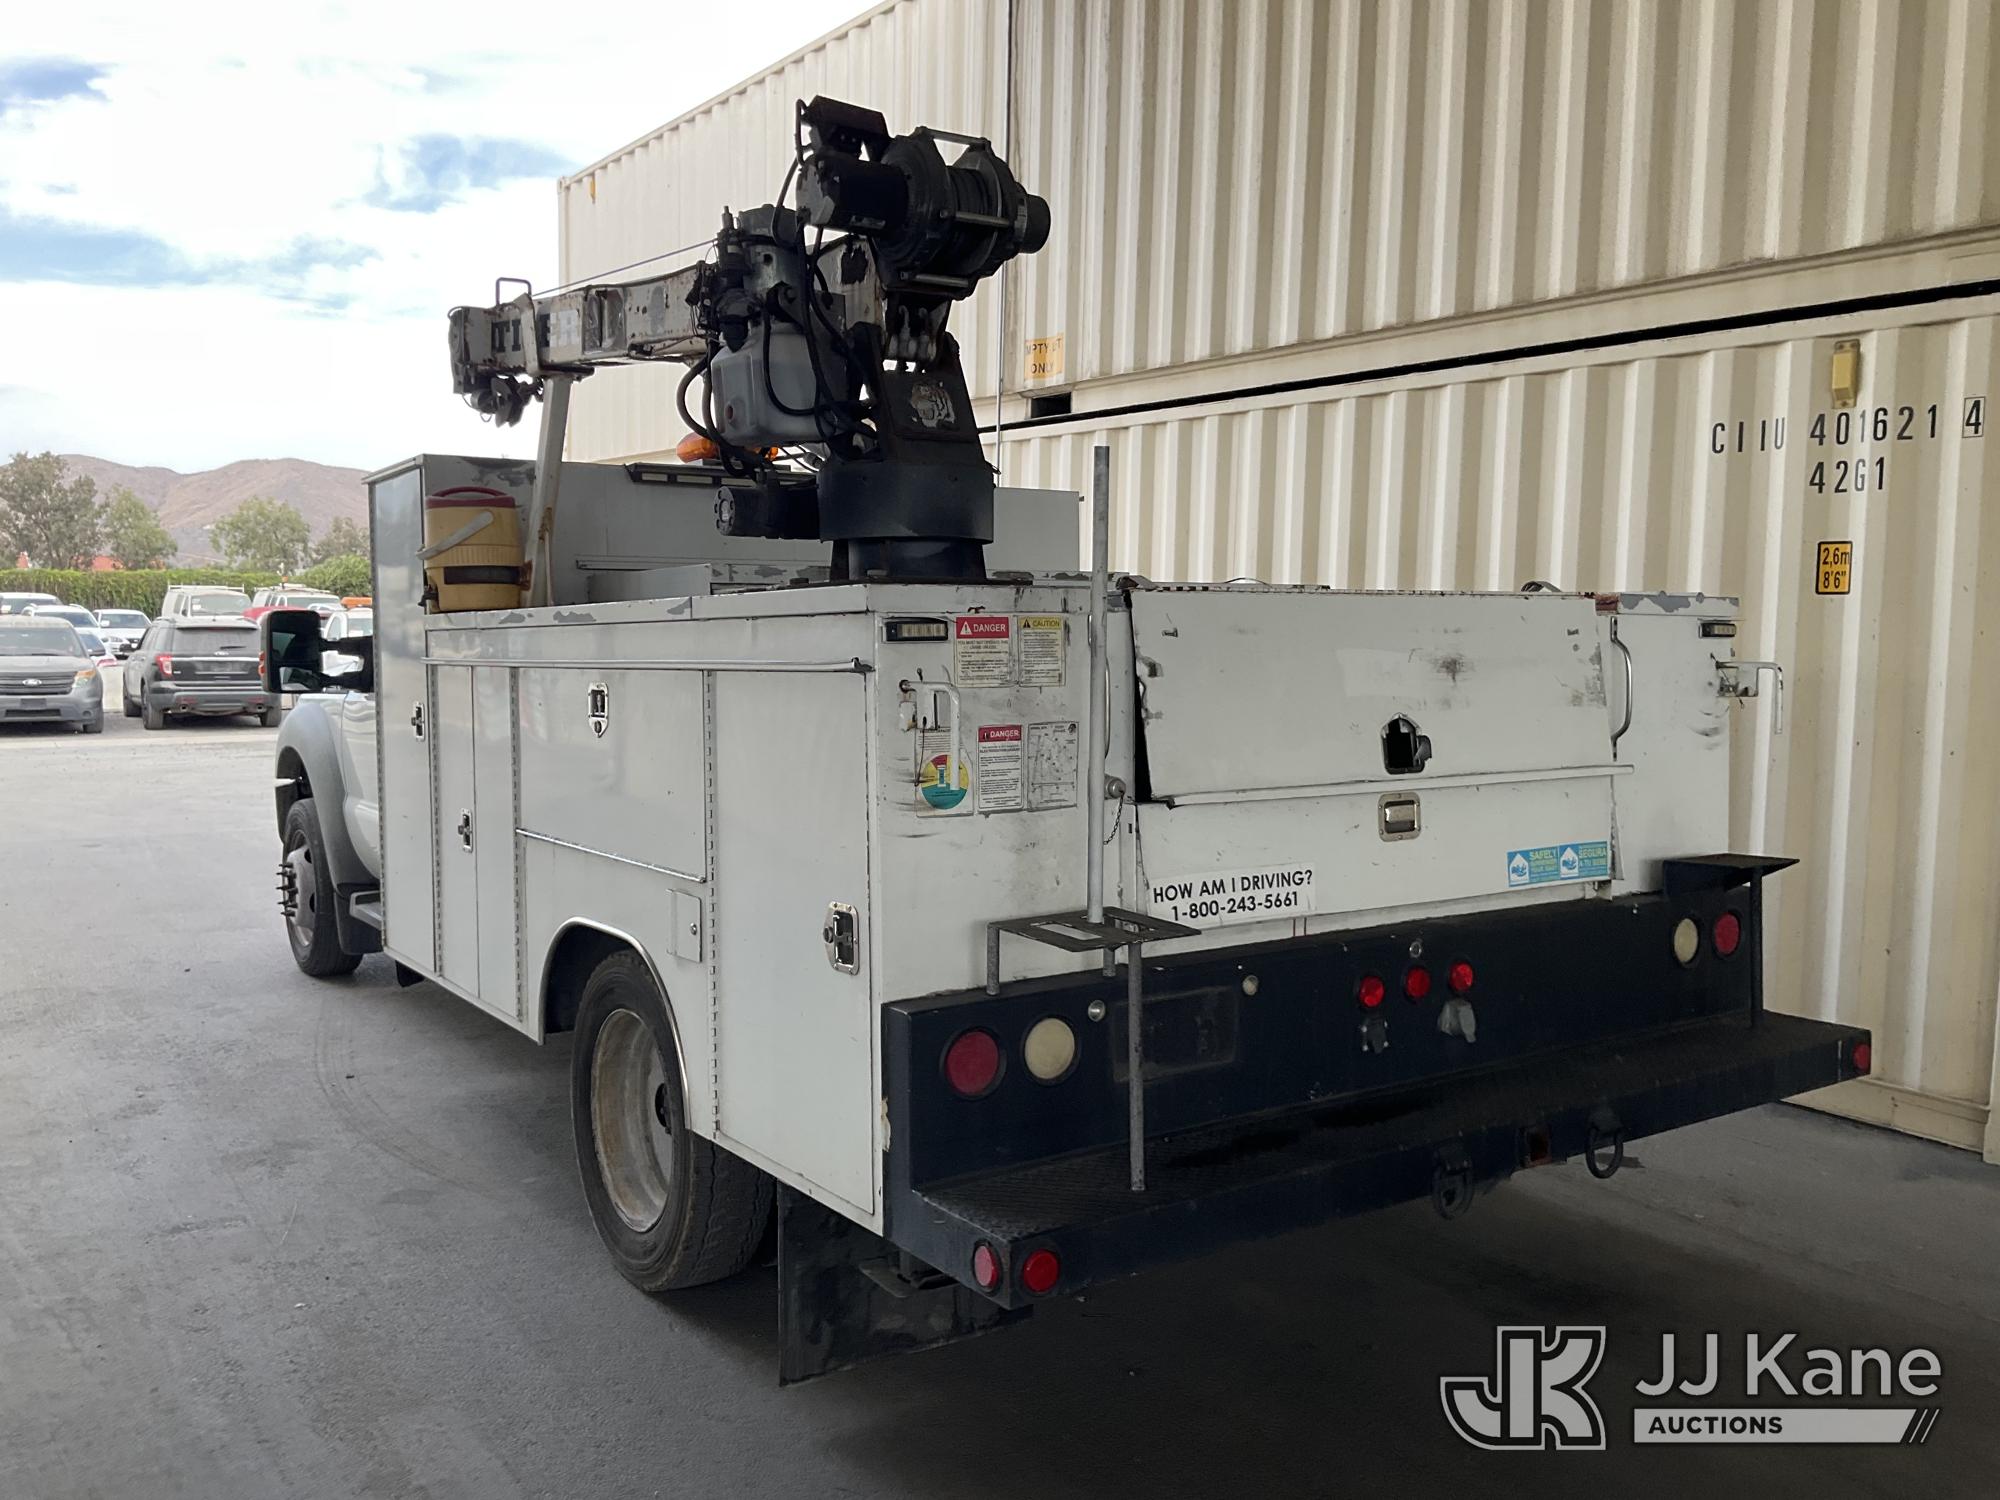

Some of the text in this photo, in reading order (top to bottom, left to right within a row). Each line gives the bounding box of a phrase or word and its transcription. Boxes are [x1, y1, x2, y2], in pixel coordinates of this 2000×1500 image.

[491, 309, 577, 353] TIER
[1712, 399, 1982, 454] CIIU 401621 4
[1809, 456, 1885, 494] 42G1
[973, 623, 1006, 632] DANGER
[1032, 619, 1060, 628] CAUTION
[989, 730, 1020, 738] DANGER
[1578, 847, 1607, 859] SEGURA
[1153, 869, 1313, 904] HOW AM I DRIVING?
[1171, 891, 1298, 921] 1-800-243-5661
